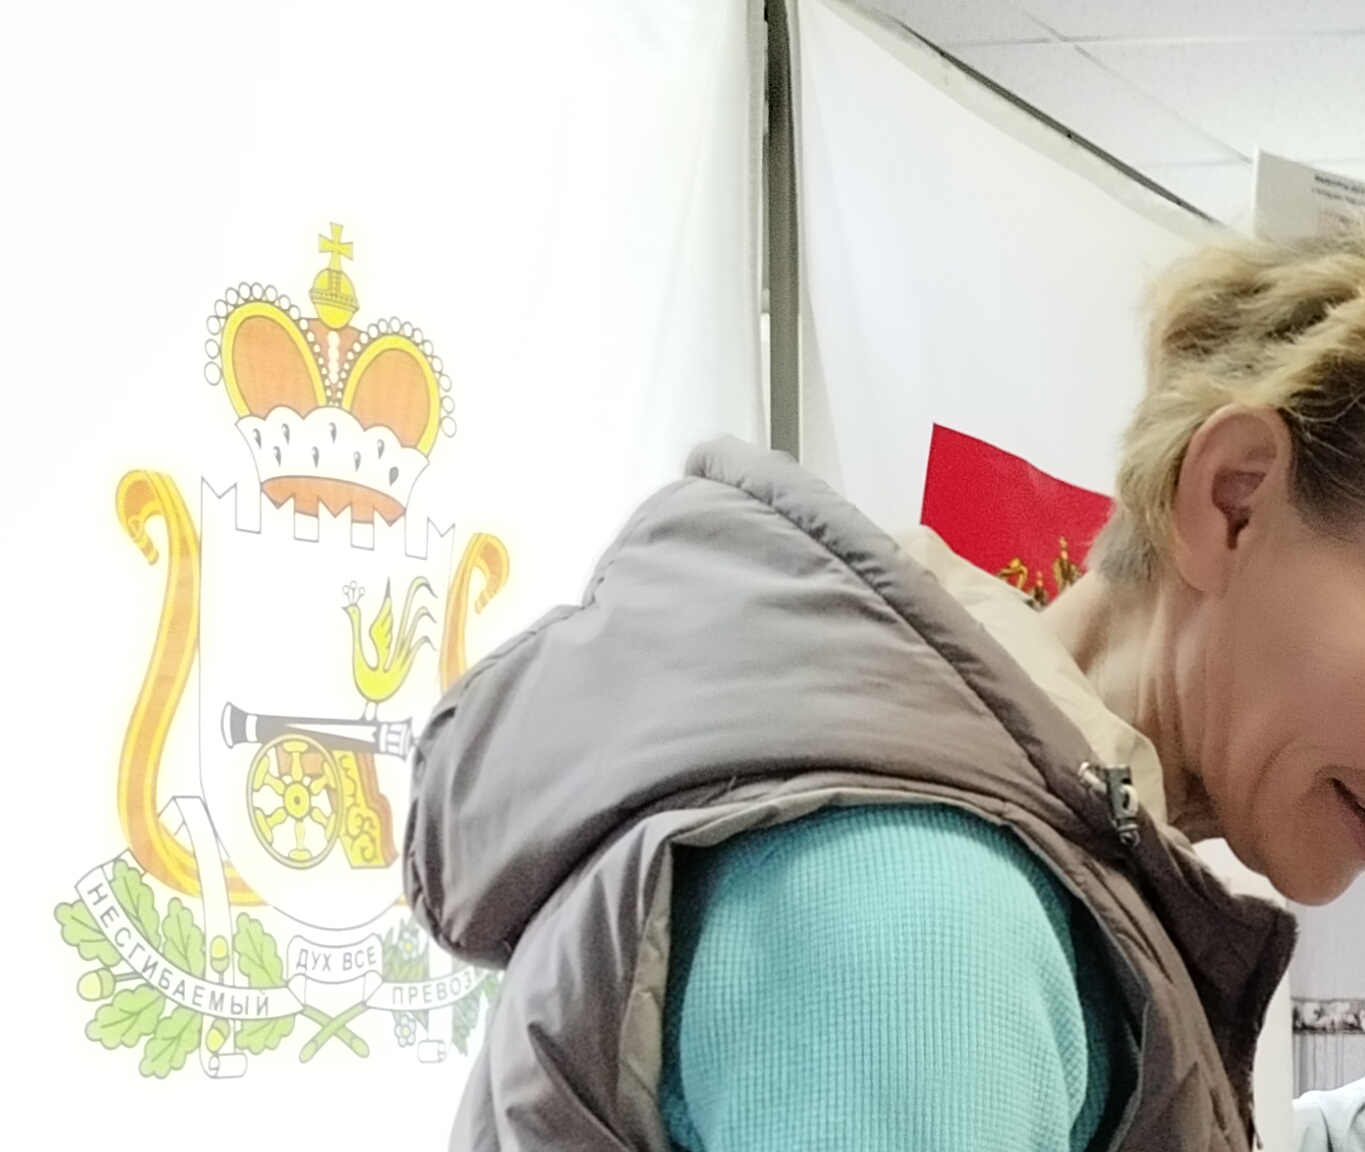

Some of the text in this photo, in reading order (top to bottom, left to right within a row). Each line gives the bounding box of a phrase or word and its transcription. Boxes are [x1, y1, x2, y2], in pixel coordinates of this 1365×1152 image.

[87, 883, 269, 1016] НЕСГИБАЕМЫЙ
[296, 946, 377, 974] ДУХ ВСЕ
